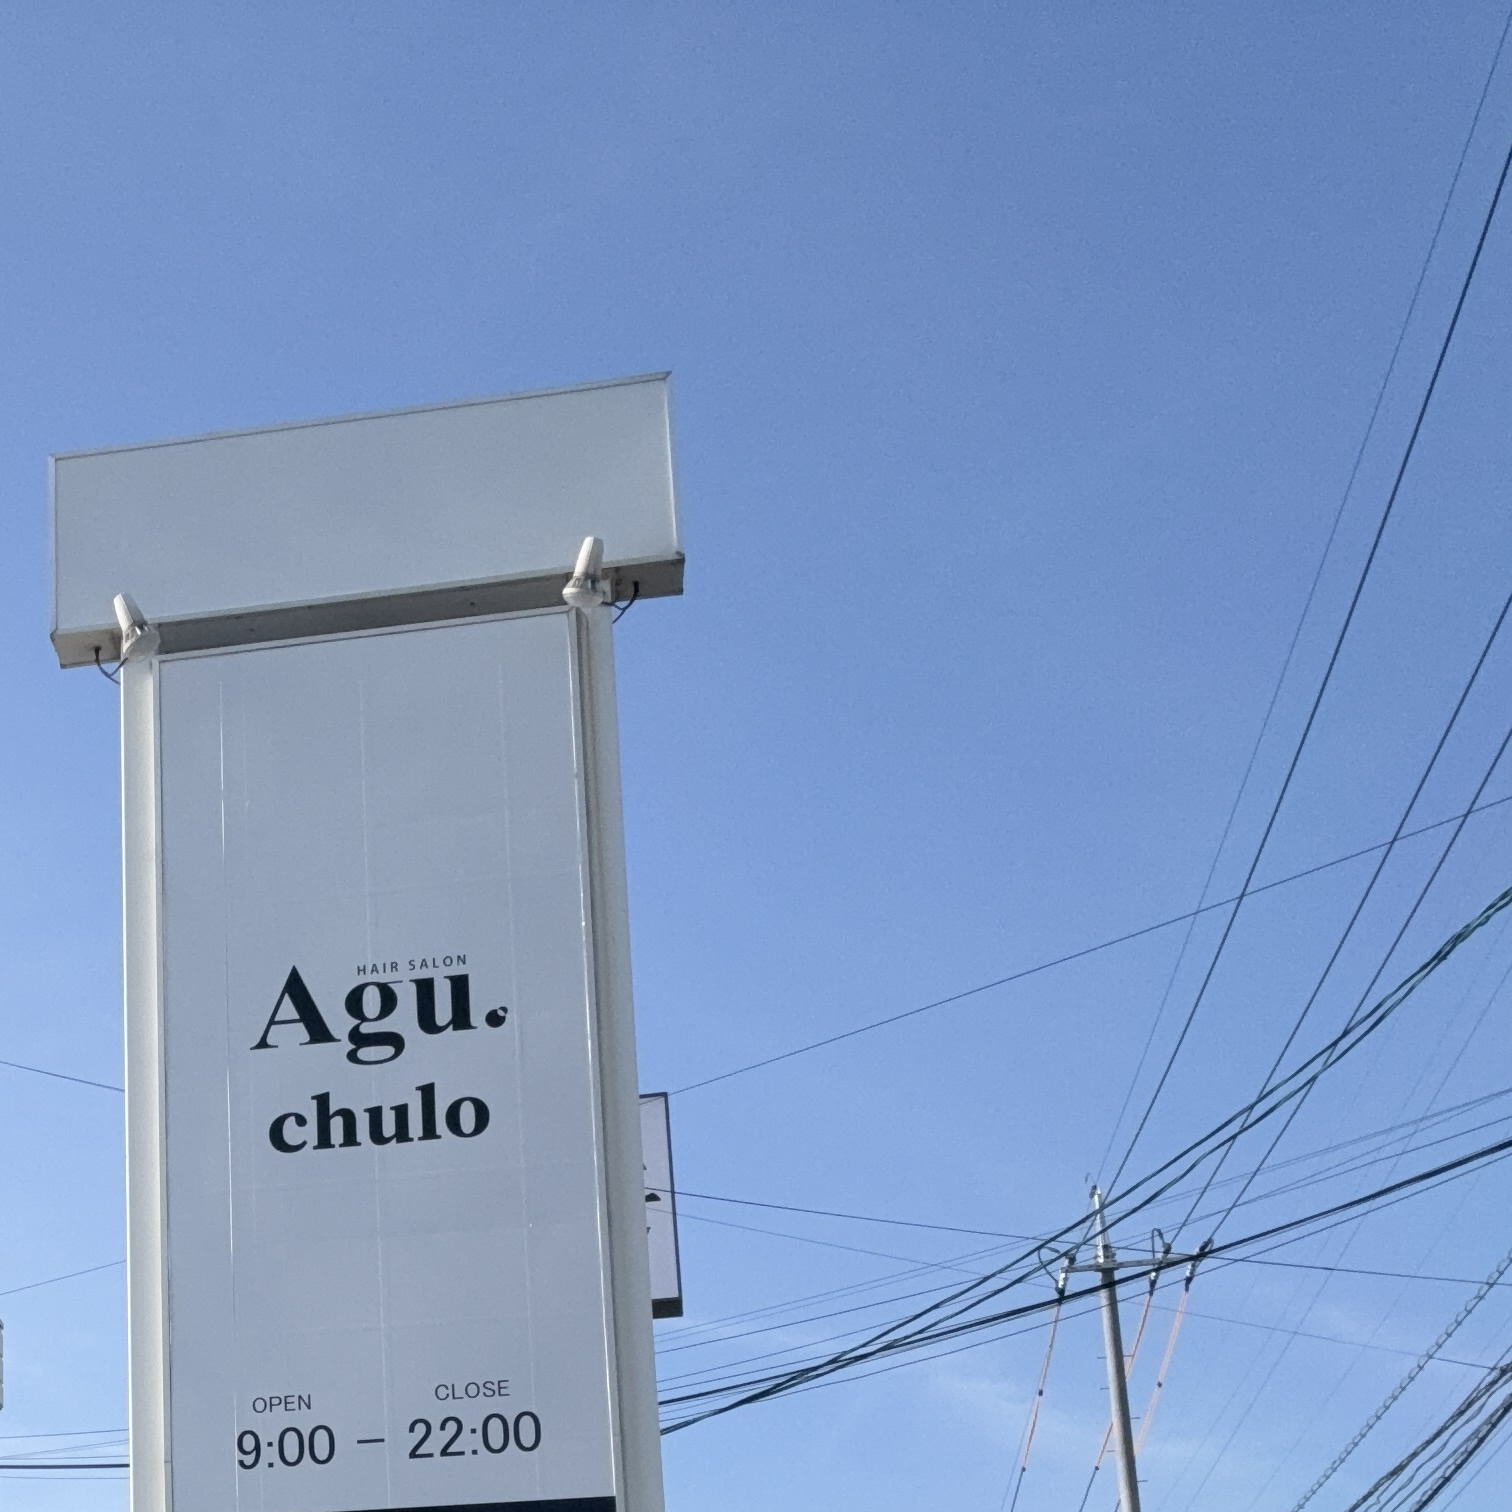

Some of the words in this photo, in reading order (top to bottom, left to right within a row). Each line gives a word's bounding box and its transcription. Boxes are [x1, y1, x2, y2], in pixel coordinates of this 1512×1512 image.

[356, 960, 400, 977] HAIR
[408, 953, 468, 972] SALON
[249, 964, 509, 1066] Agu.
[268, 1081, 491, 1154] chulo
[251, 1393, 313, 1414] OPEN
[434, 1379, 511, 1402] CLOSE
[236, 1424, 336, 1470] 9:00
[407, 1410, 542, 1460] 22:00
